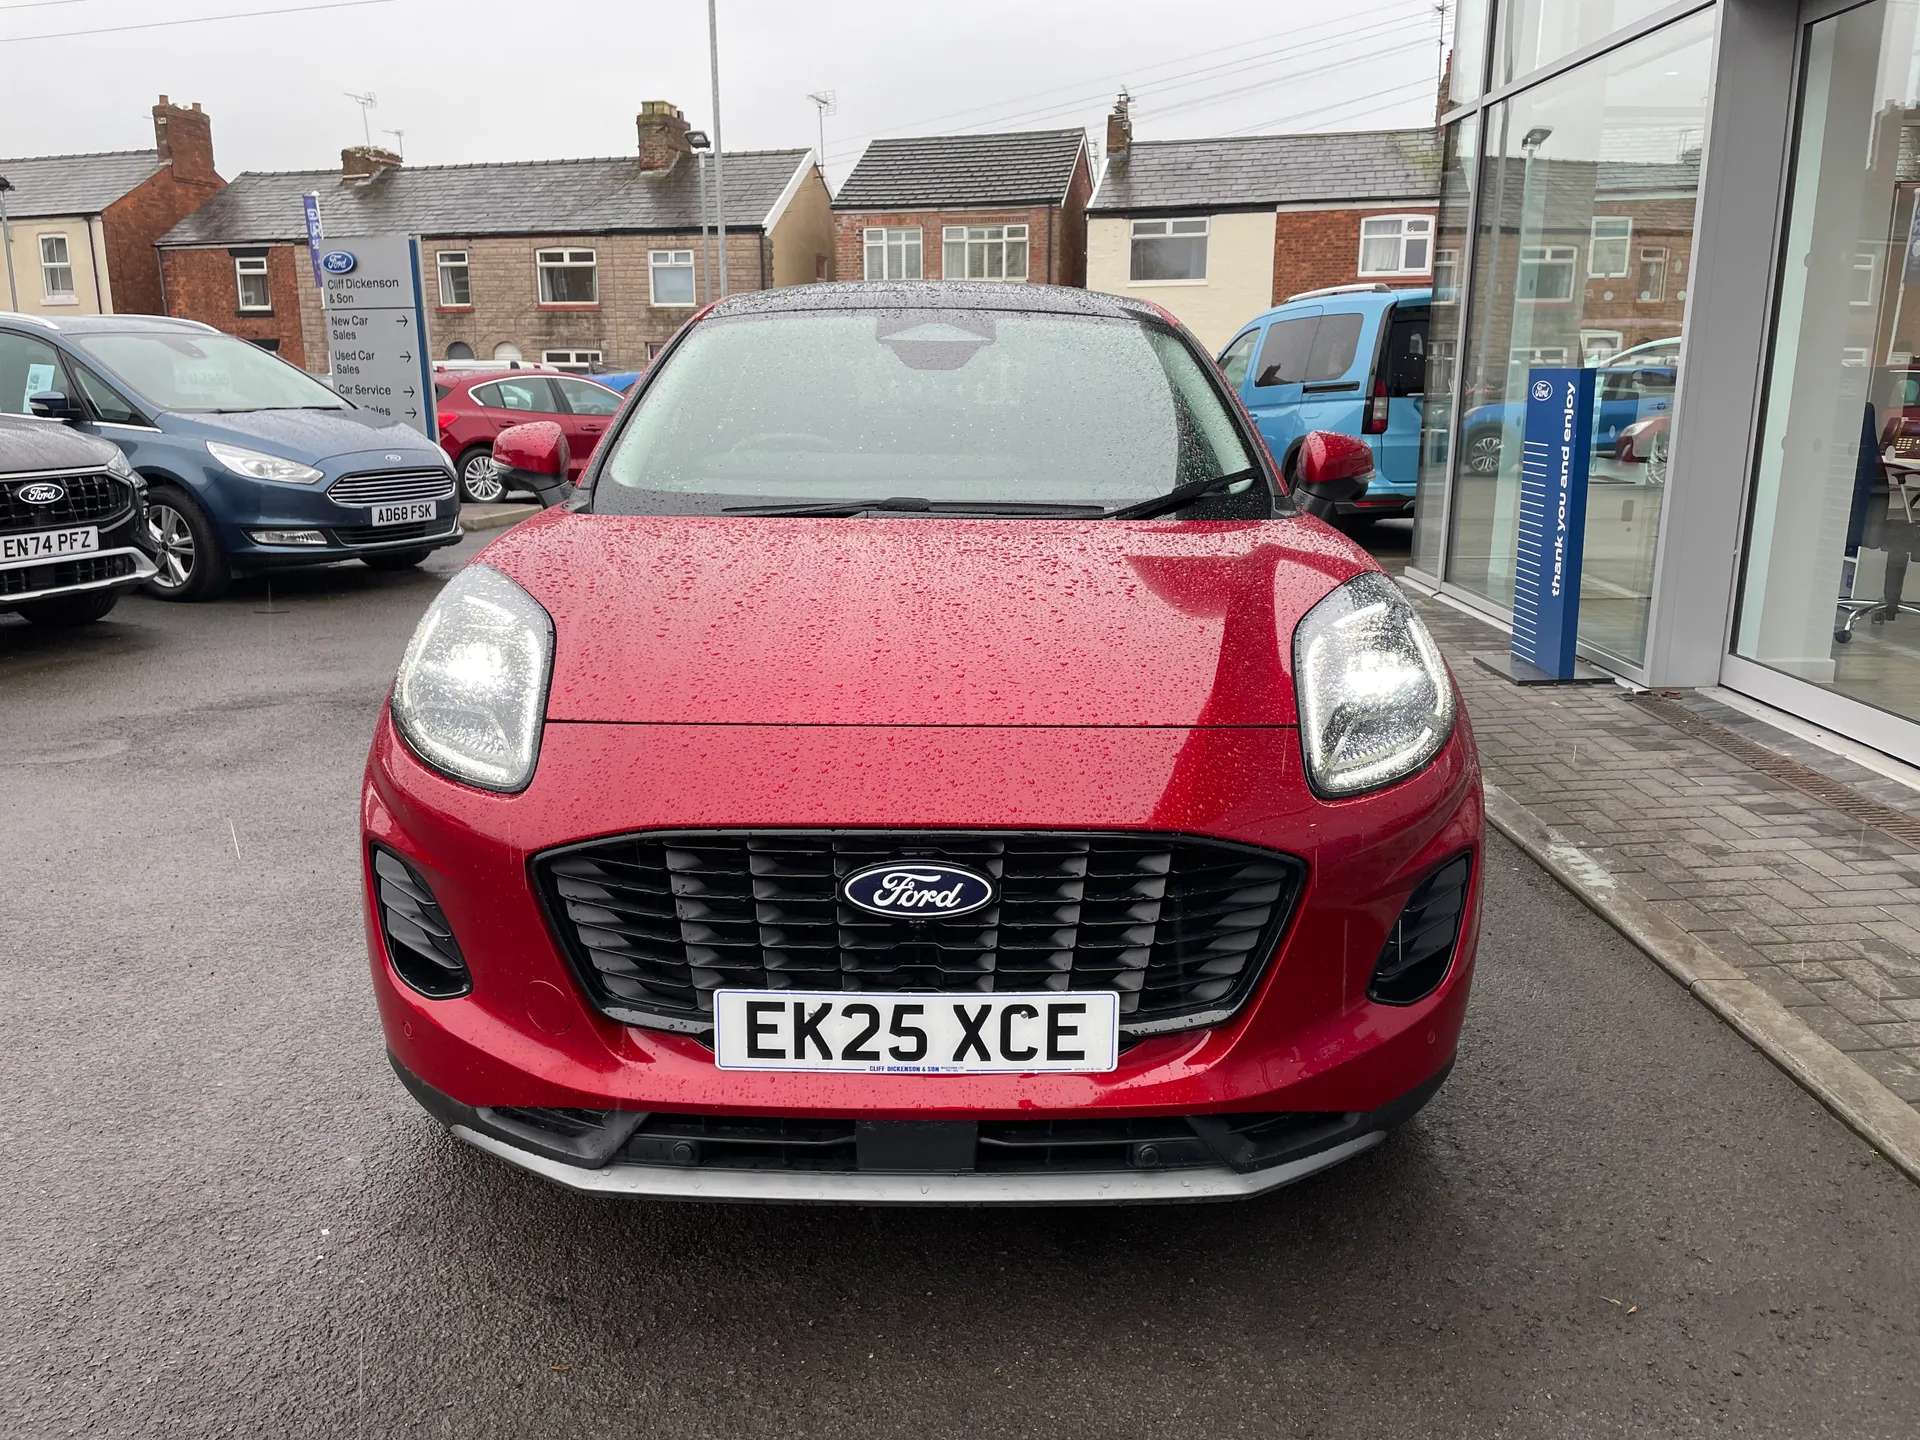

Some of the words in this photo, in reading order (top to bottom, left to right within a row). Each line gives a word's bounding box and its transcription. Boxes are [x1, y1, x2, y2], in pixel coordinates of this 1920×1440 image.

[327, 255, 347, 269] Ford
[327, 278, 344, 290] Cliff
[345, 278, 399, 289] Dickenson
[329, 294, 336, 304] &
[336, 293, 354, 304] Son
[331, 315, 350, 327] New
[351, 315, 368, 326] Car
[332, 329, 357, 341] Sales
[335, 350, 357, 361] Used
[358, 350, 375, 361] Car
[336, 364, 360, 375] Sales
[338, 383, 353, 395] Car
[354, 384, 392, 396] Service
[1563, 381, 1576, 442] enjoy
[1560, 446, 1570, 489] and
[28, 486, 55, 501] Ford
[378, 506, 408, 523] AD68
[411, 504, 432, 519] FSK
[1557, 492, 1567, 531] you
[3, 535, 53, 558] EN74
[57, 530, 91, 551] PFZ
[1551, 535, 1564, 597] thank
[872, 872, 964, 908] Ford
[746, 1001, 927, 1062] EK25
[951, 1003, 1087, 1062] XCE
